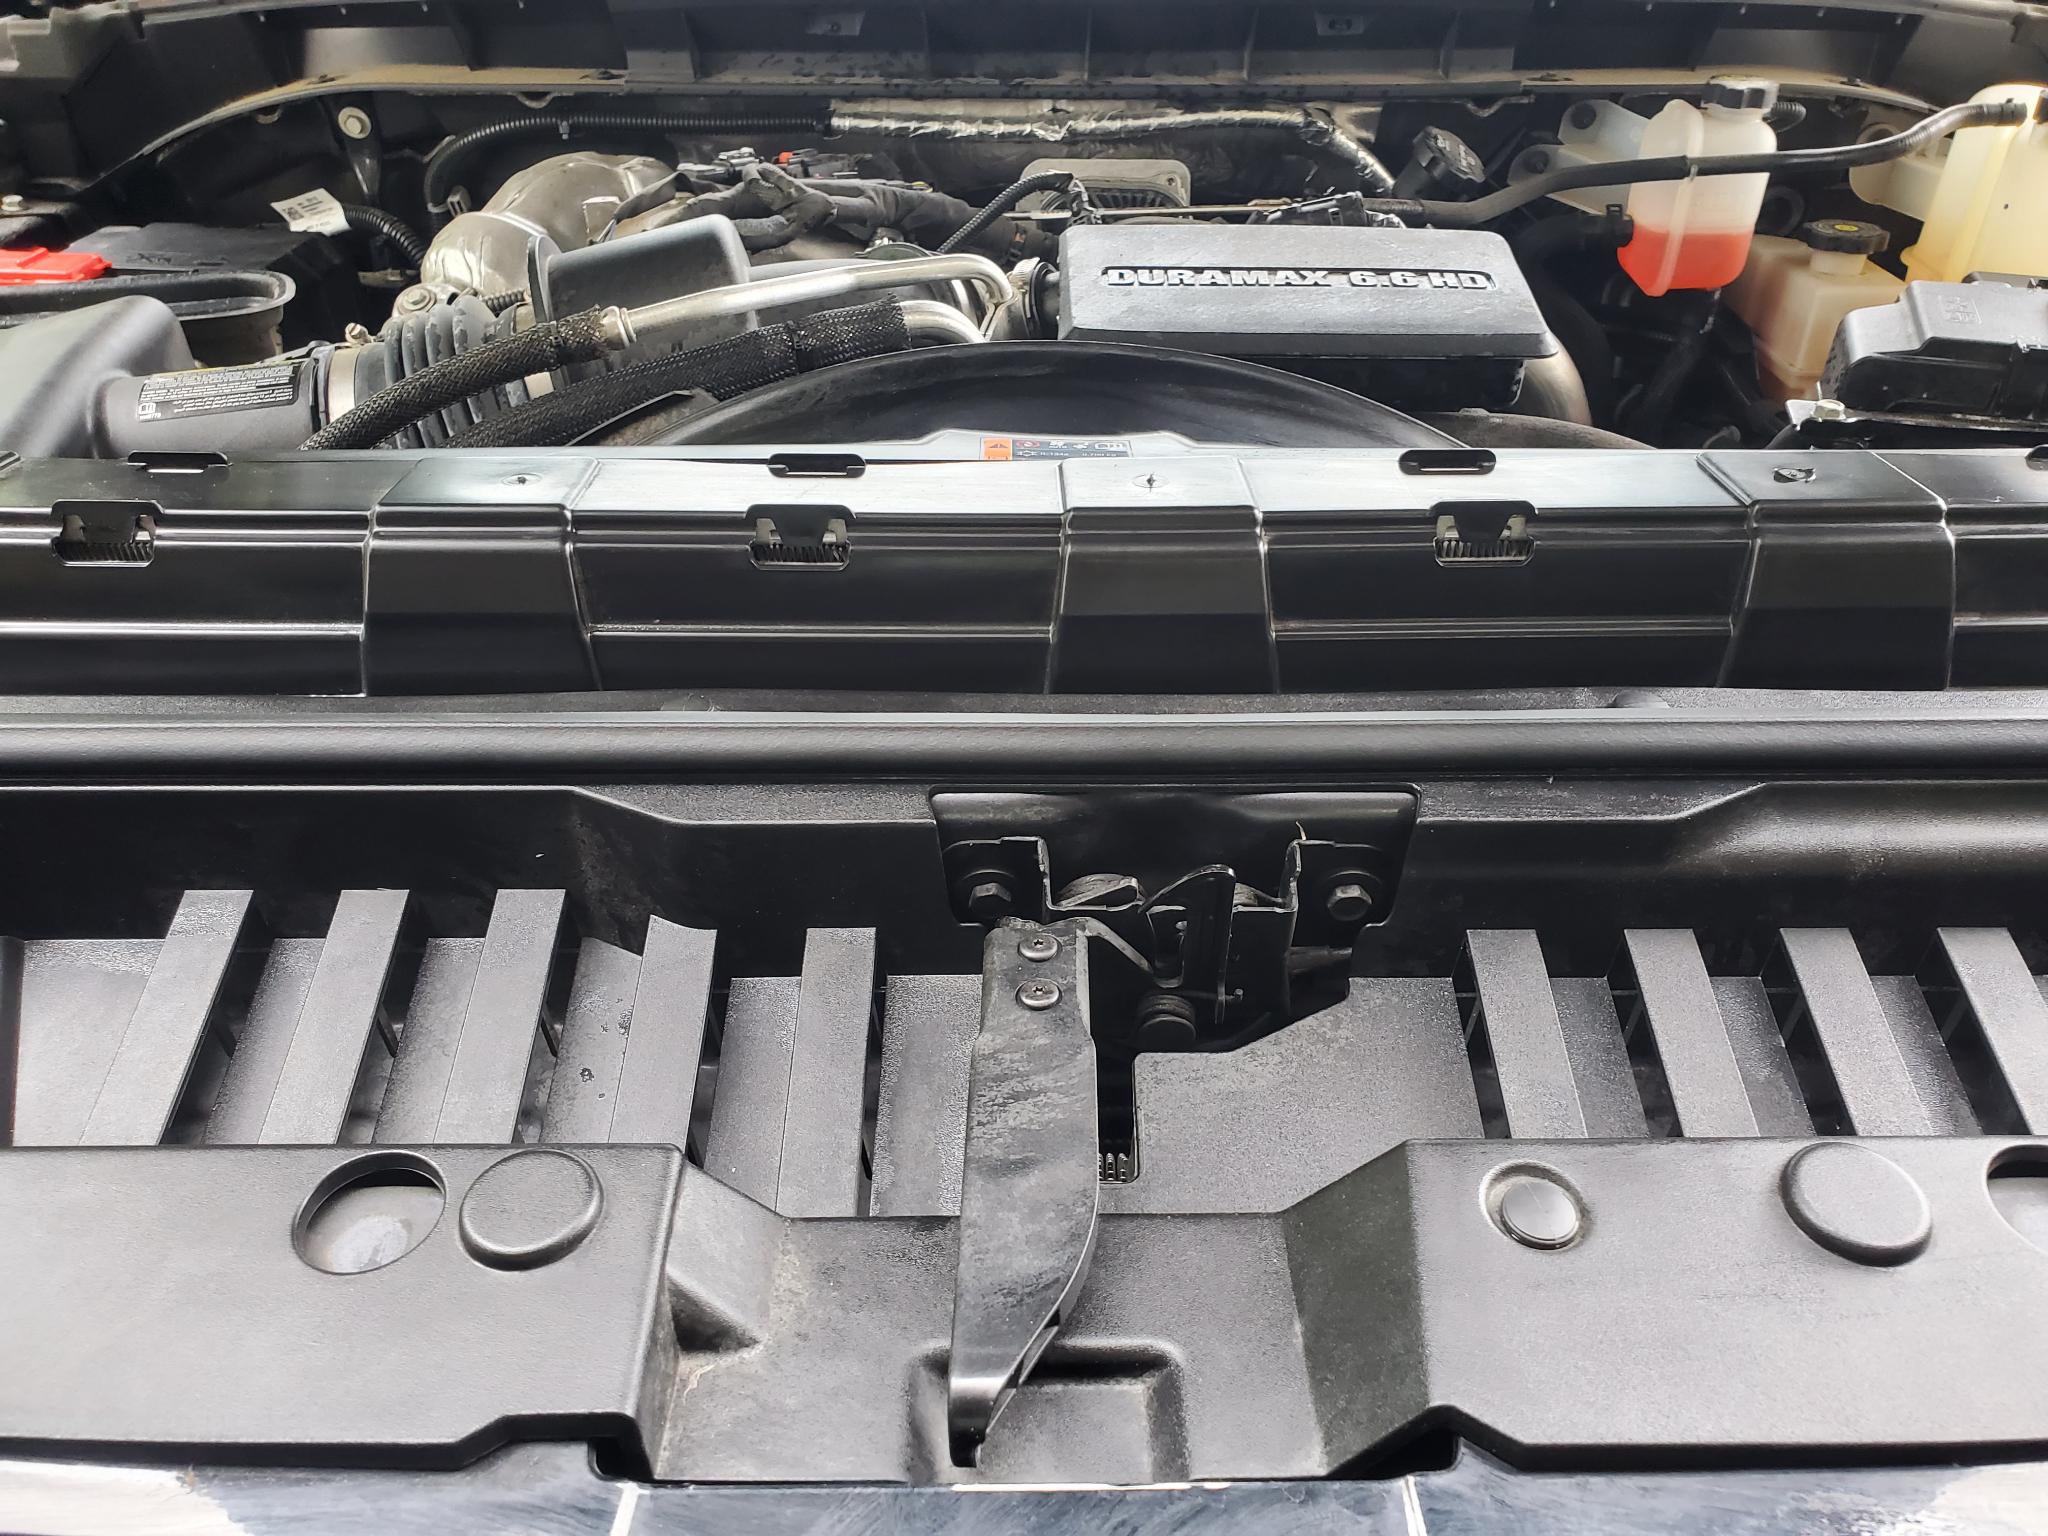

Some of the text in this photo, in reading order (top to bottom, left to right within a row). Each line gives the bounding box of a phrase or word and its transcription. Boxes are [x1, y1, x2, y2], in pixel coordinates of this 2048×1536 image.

[1107, 269, 1488, 290] DURAMAX 6.6 HD
